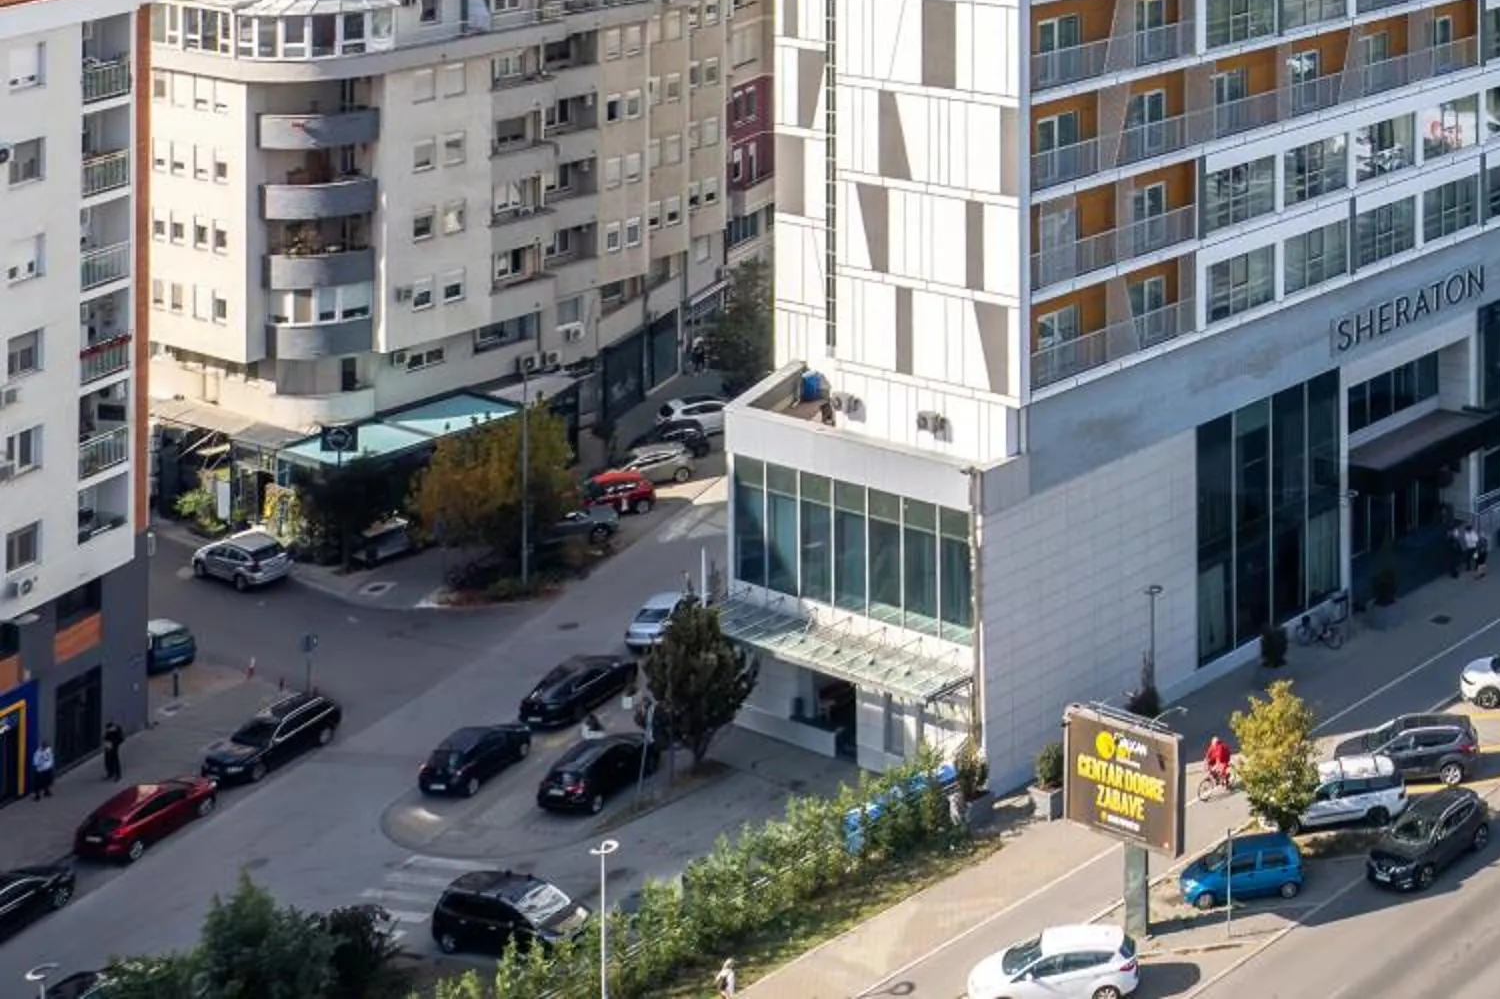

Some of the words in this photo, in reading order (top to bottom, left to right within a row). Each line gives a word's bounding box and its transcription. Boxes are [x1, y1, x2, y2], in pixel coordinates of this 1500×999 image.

[1337, 264, 1486, 352] SHERATON
[1077, 753, 1125, 790] CENTAR
[1095, 784, 1145, 821] ZABAVE
